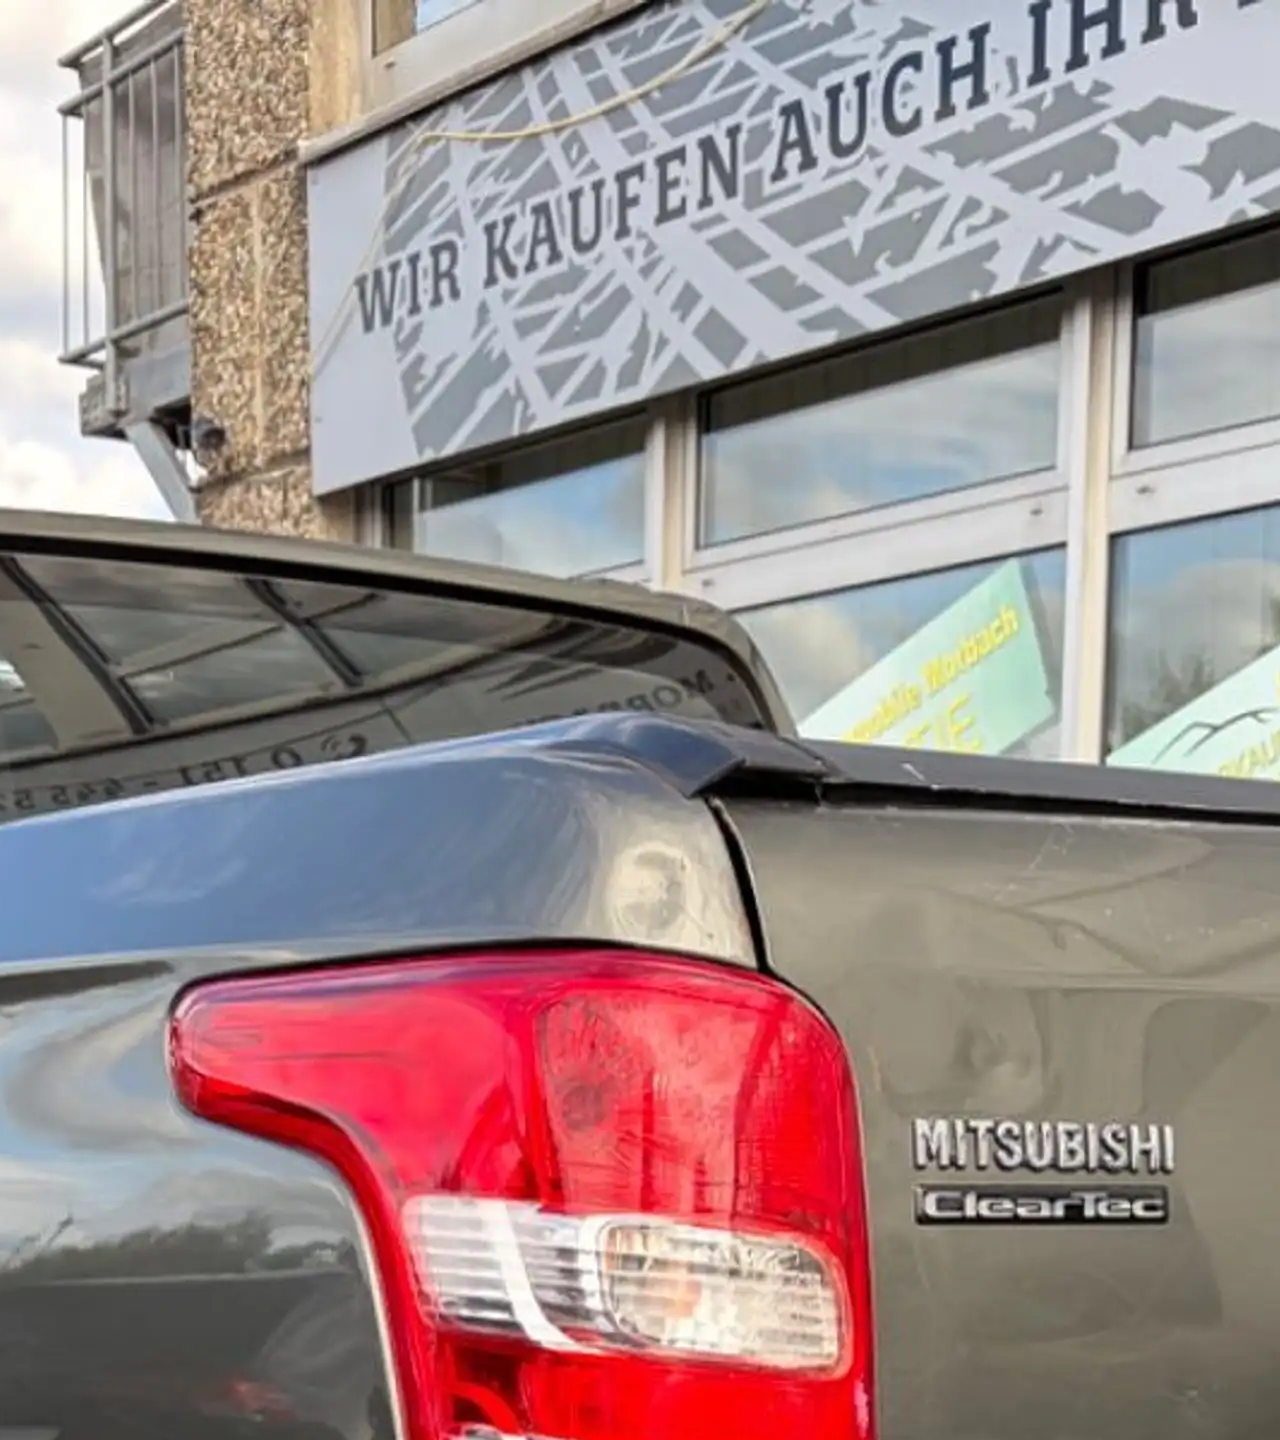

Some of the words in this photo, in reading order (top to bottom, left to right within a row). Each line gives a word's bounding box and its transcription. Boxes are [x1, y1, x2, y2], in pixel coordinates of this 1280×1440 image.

[353, 238, 461, 334] WIR
[483, 123, 741, 289] KAUFEN
[771, 21, 992, 183] AUCH
[922, 605, 1019, 699] Morbach
[914, 1117, 1175, 1173] MITSUBISHI
[923, 1190, 1167, 1219] ClearTec
